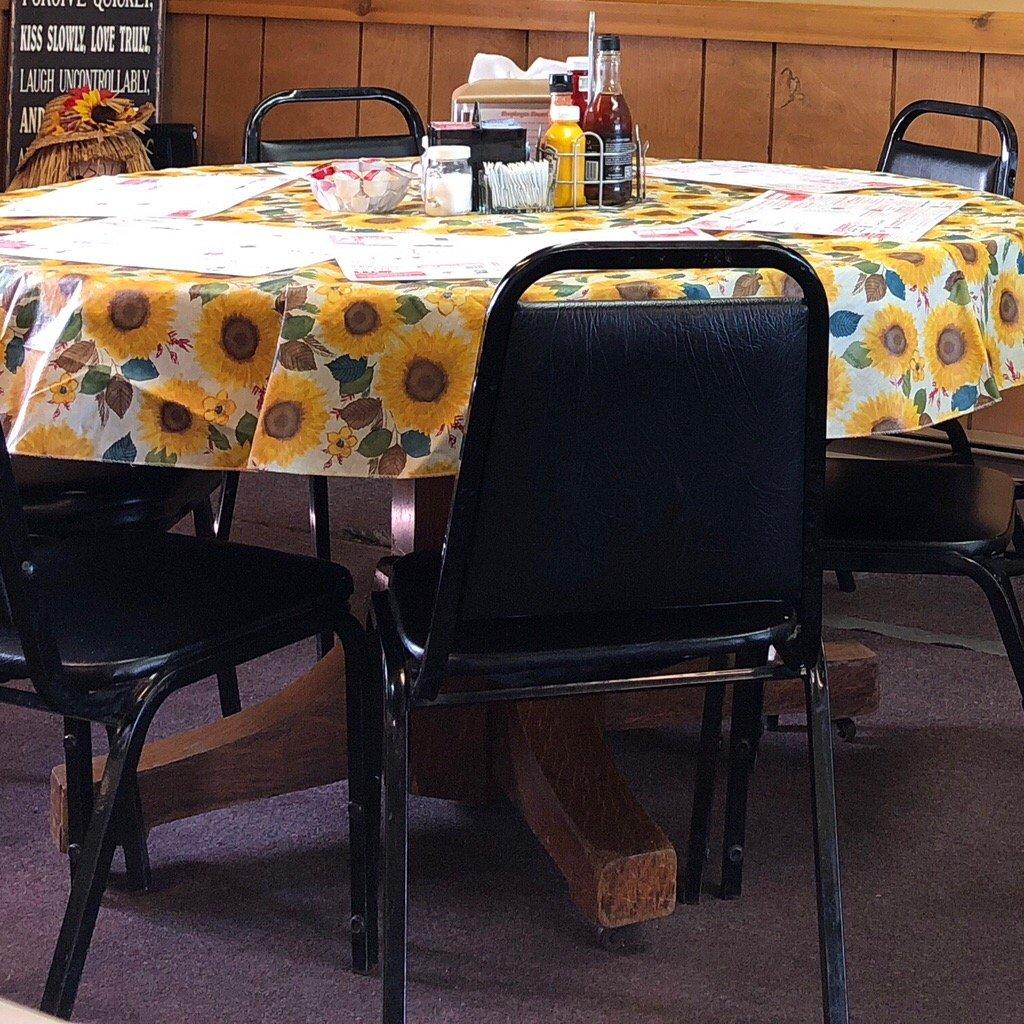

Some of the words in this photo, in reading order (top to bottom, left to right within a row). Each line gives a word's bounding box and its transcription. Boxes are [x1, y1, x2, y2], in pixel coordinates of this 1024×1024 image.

[20, 24, 43, 53] KISS
[47, 25, 87, 54] SLOWLY,
[90, 25, 116, 53] LOVE
[119, 26, 151, 55] TRULY,
[20, 68, 56, 93] LAUGH
